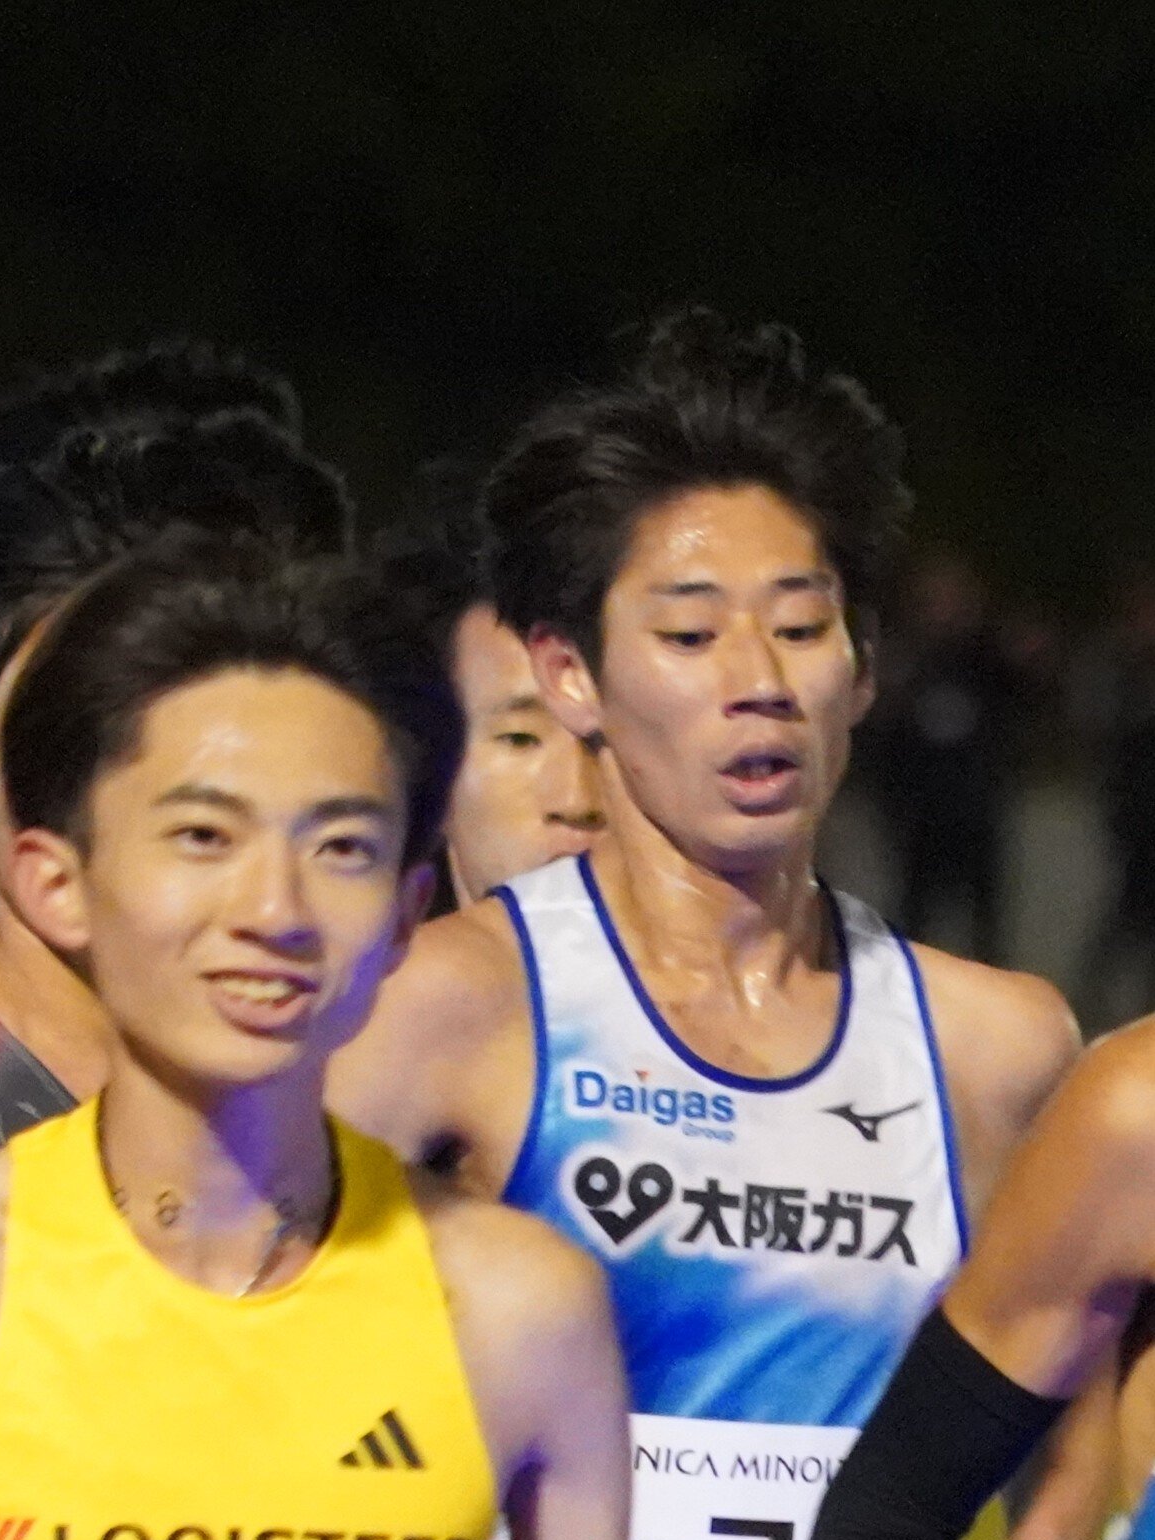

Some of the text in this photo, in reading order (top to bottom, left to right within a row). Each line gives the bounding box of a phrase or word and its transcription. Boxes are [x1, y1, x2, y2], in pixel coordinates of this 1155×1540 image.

[573, 1070, 737, 1126] Daigas
[678, 1176, 919, 1267] 大阪ガス
[633, 1444, 719, 1479] NICA
